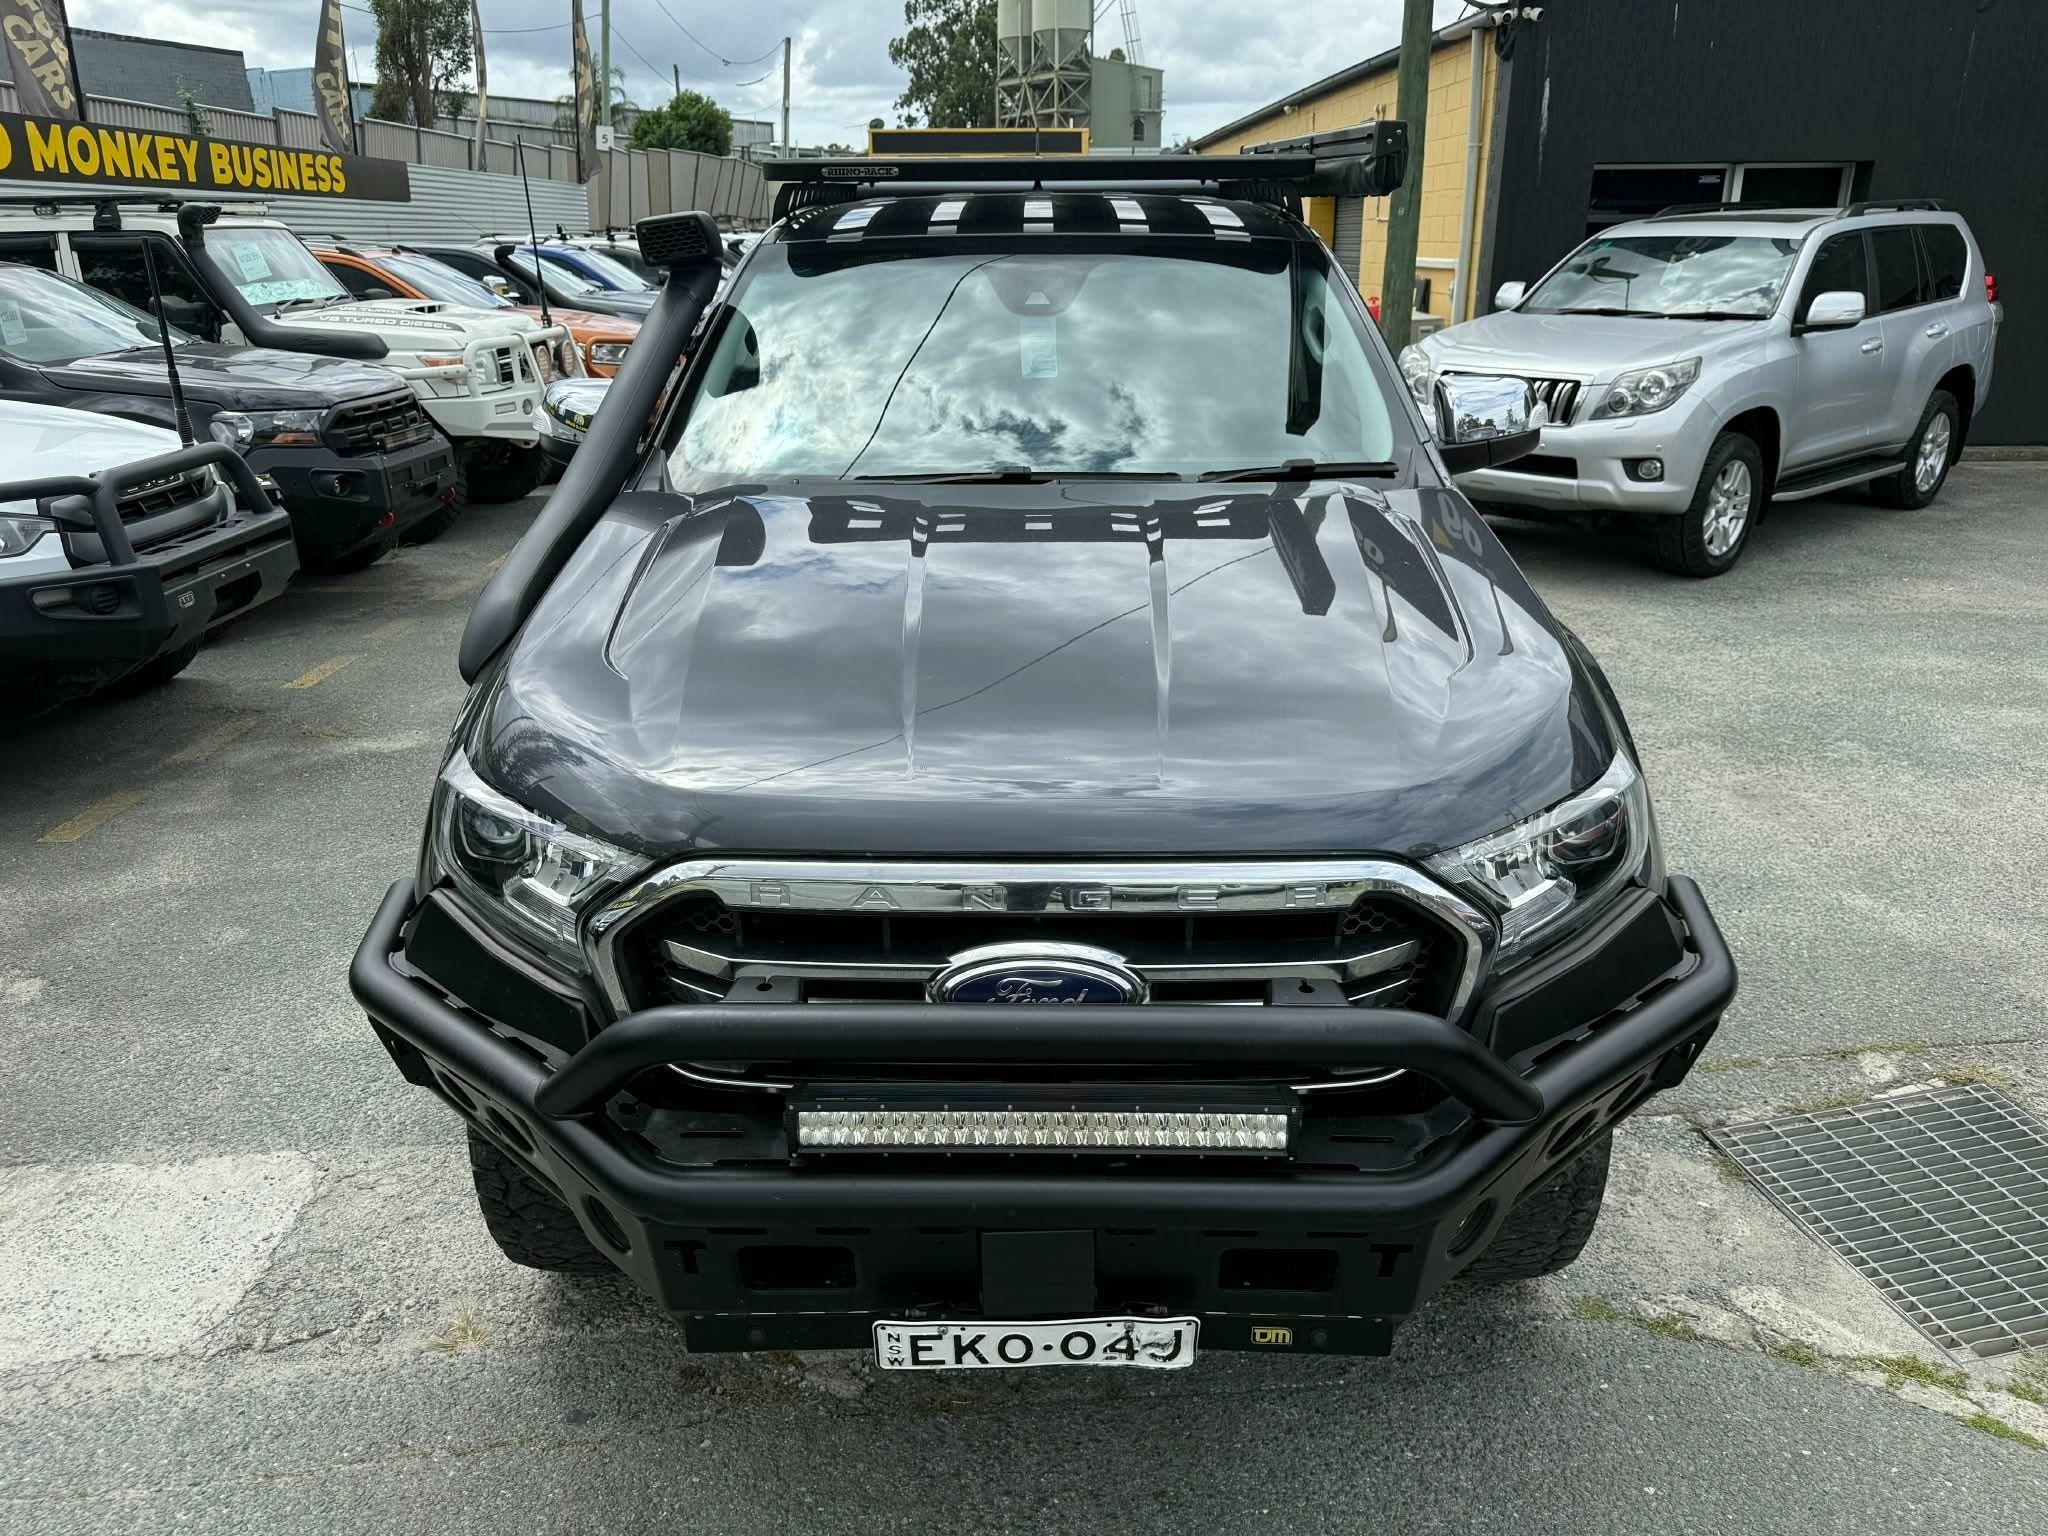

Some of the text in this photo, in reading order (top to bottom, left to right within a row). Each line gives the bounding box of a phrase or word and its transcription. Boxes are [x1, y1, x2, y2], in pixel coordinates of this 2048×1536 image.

[3, 15, 76, 110] CARS
[602, 134, 608, 144] 5
[25, 120, 199, 183] MONKEY
[208, 142, 346, 193] BUSINESS
[827, 167, 895, 177] RHINO-RACK
[319, 314, 453, 330] V8 TURBO DIESEL
[750, 882, 1327, 911] RANGER
